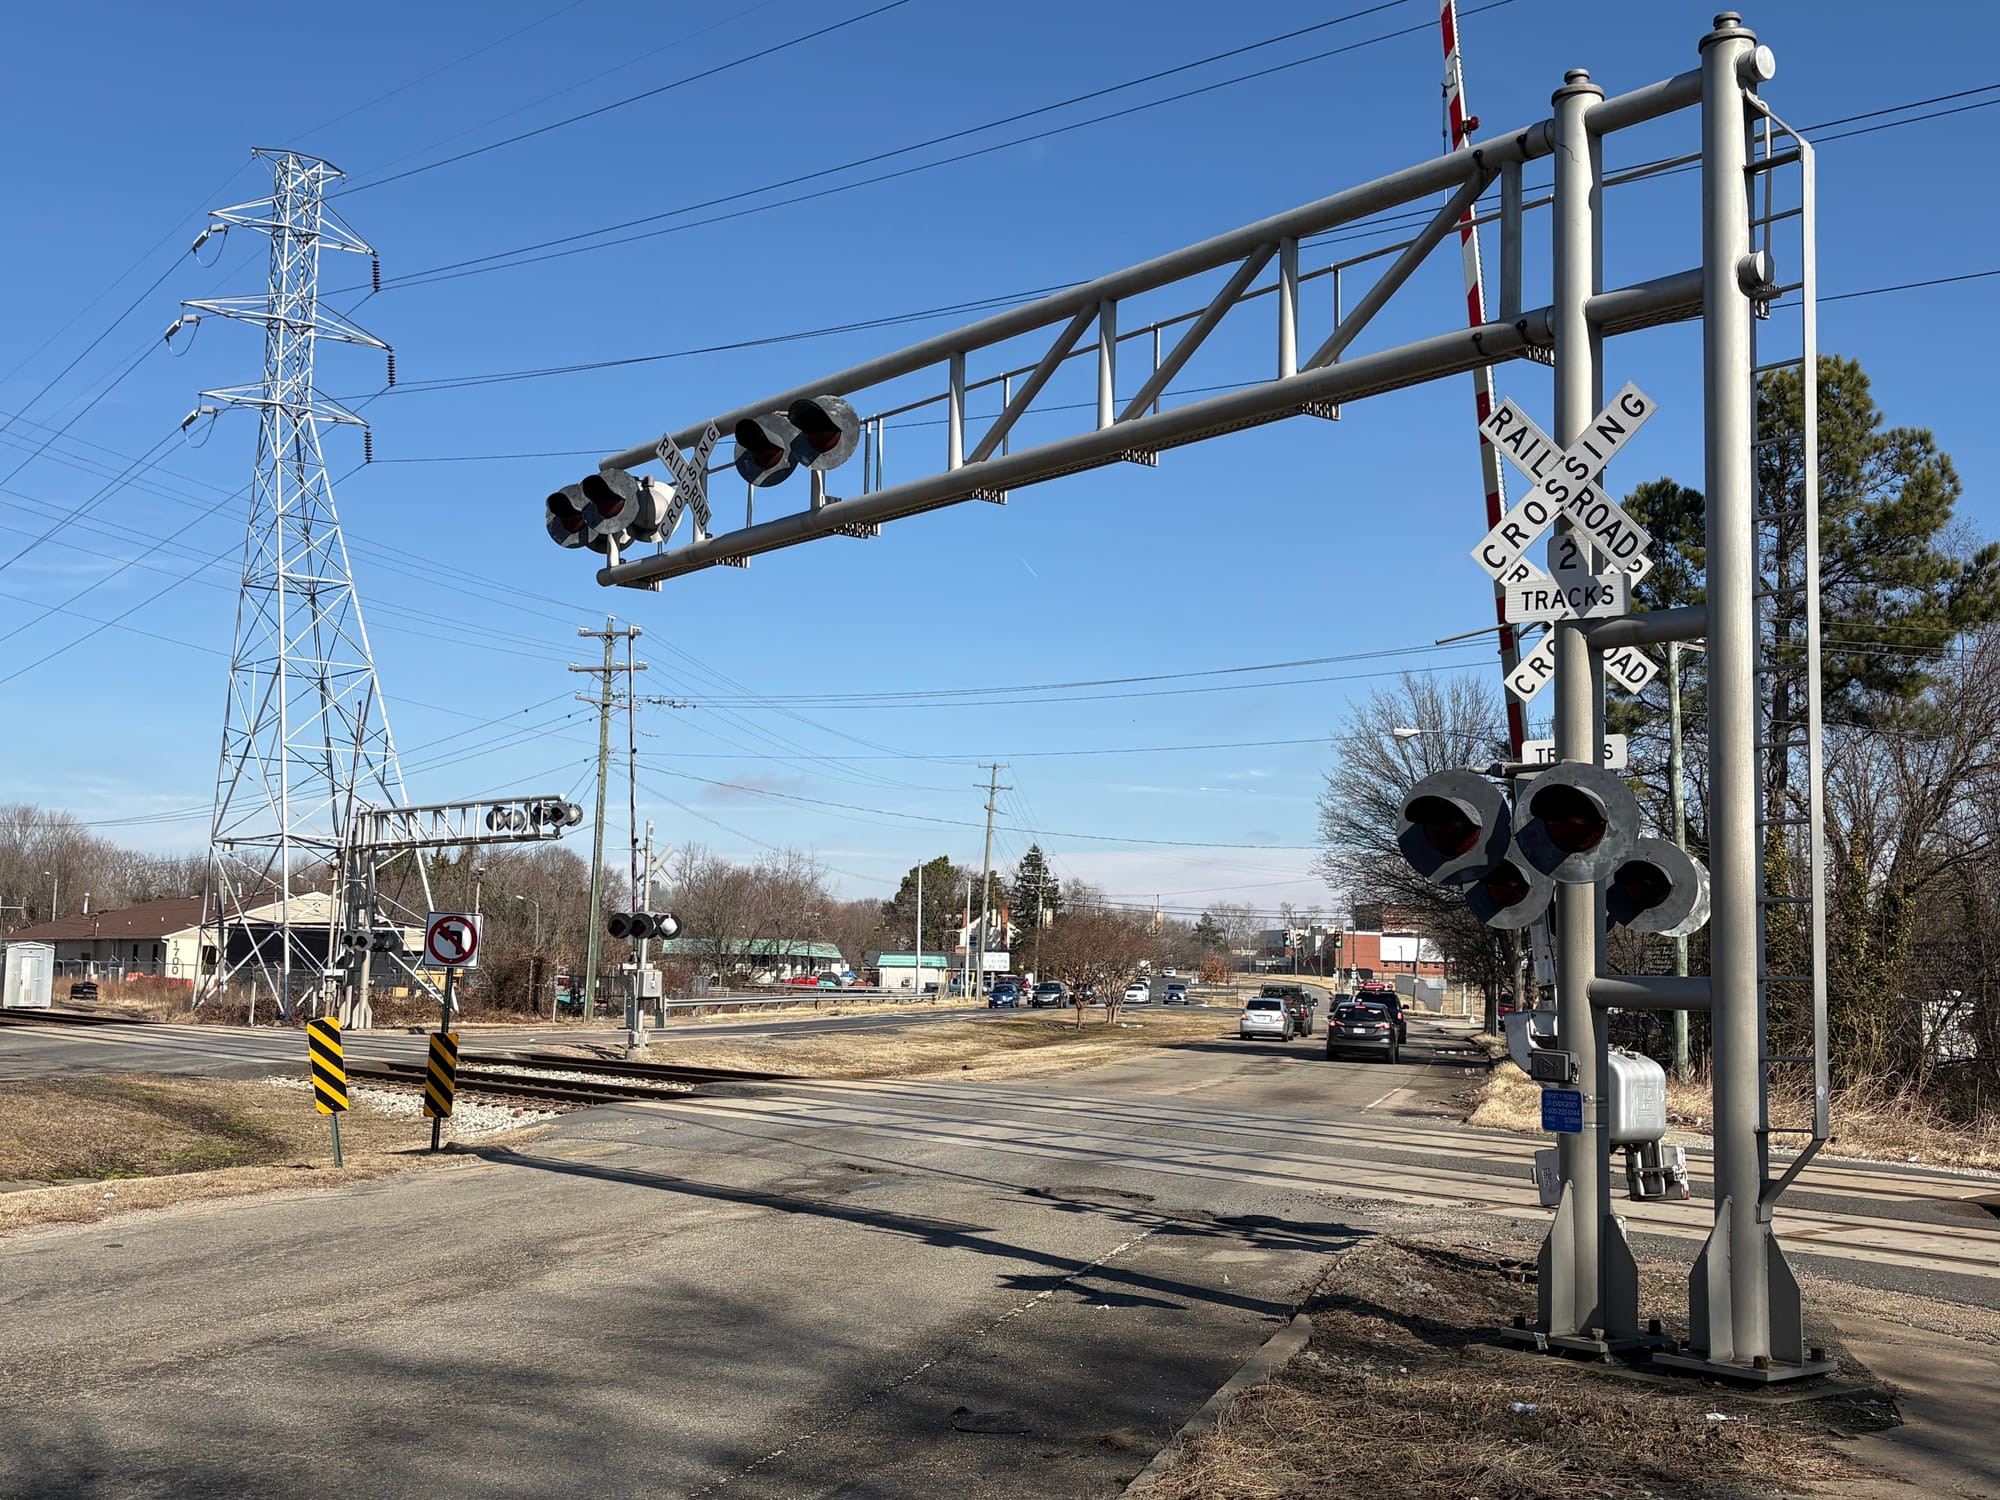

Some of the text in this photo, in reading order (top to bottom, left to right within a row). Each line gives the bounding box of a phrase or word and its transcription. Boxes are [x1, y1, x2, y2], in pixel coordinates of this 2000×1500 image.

[661, 426, 716, 537] CROSSING
[1483, 393, 1645, 568] CROSSING
[1558, 541, 1577, 570] 2
[1521, 585, 1614, 611] TRACKS
[172, 939, 180, 975] 1700
